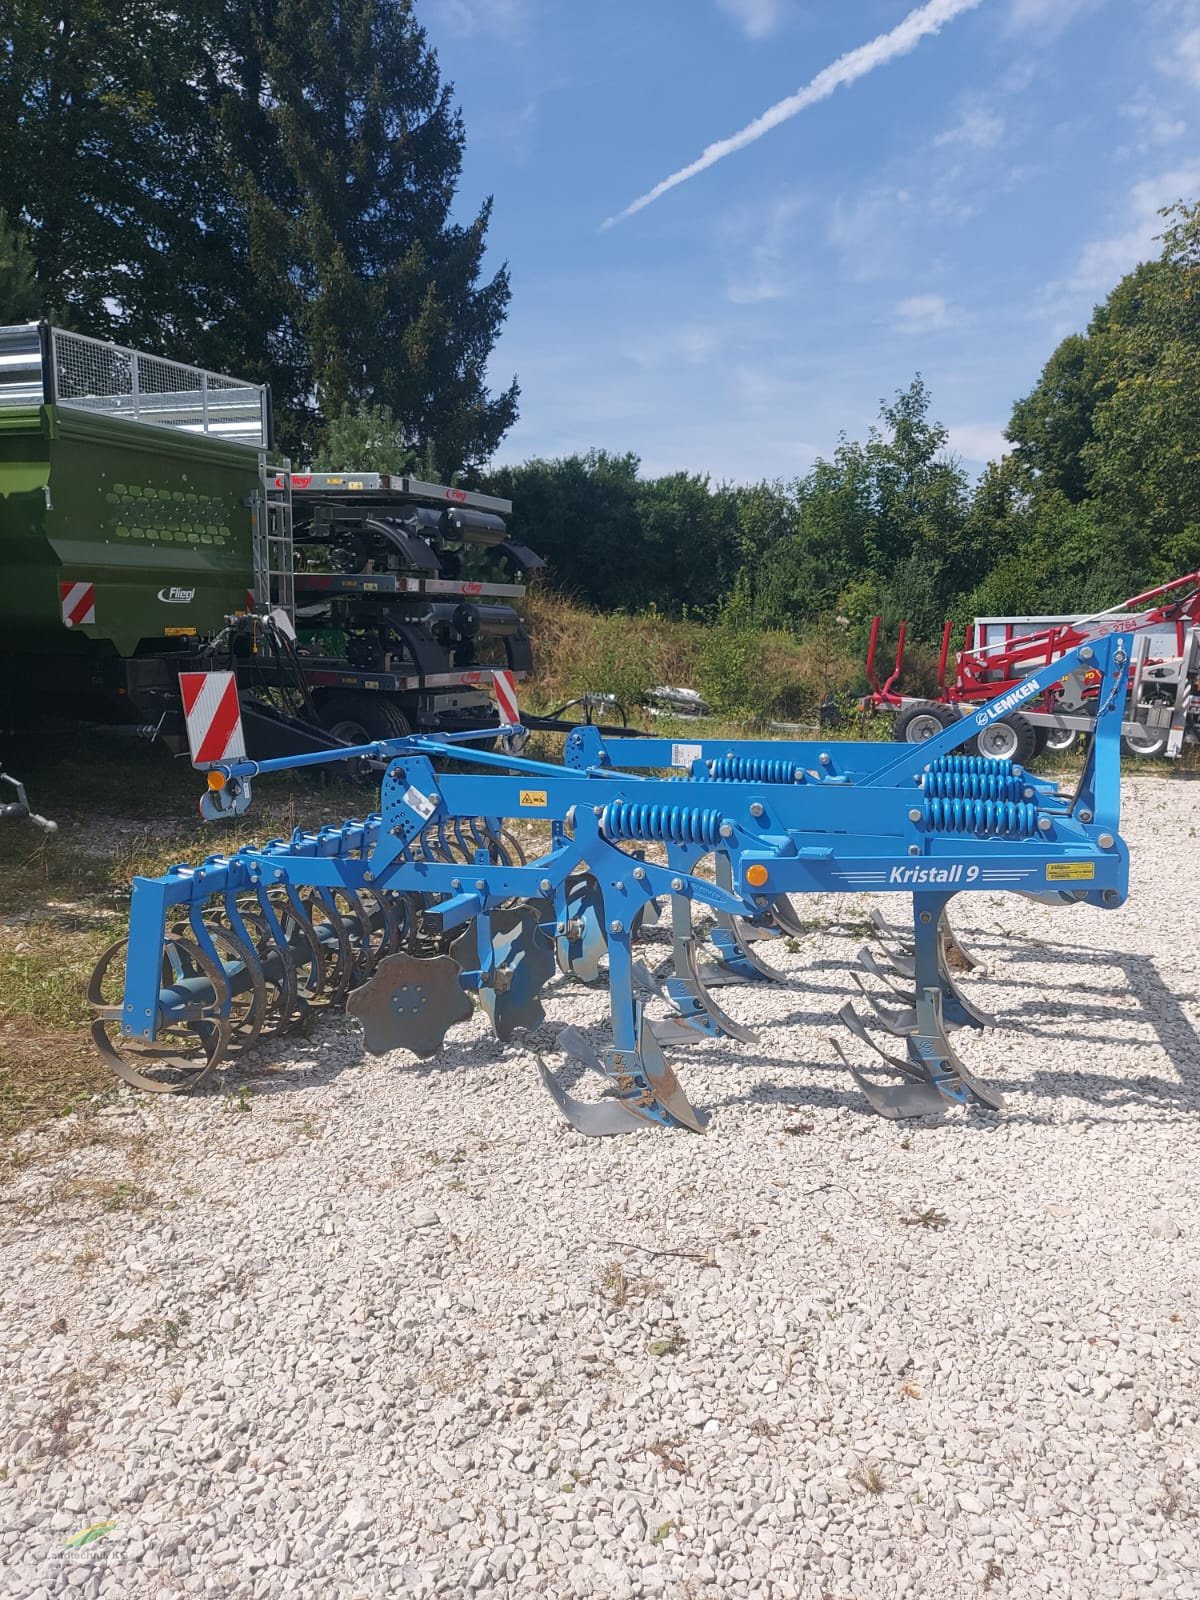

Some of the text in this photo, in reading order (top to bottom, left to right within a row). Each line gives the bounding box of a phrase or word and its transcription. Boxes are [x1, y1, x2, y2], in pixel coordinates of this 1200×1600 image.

[169, 586, 196, 601] Fliegl
[1112, 619, 1138, 633] 2764
[986, 679, 1040, 719] LEMKEN
[889, 864, 980, 885] Kristall 9
